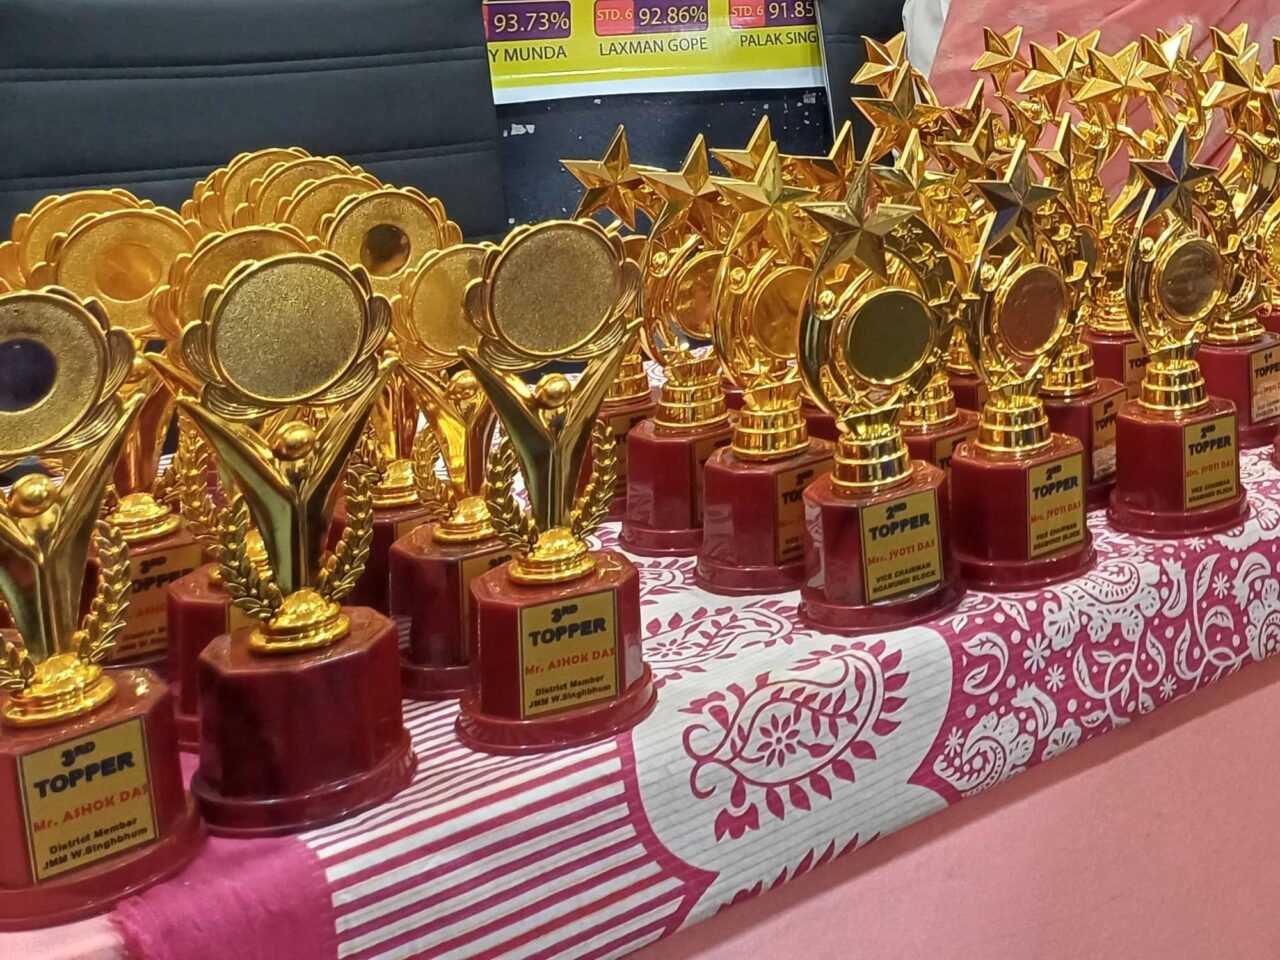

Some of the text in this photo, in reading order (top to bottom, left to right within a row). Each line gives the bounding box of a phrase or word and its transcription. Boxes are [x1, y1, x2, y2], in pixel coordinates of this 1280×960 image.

[493, 10, 570, 33] 93.73%
[597, 7, 625, 22] STD.
[638, 5, 707, 27] 92.86%
[731, 5, 754, 17] STD.
[599, 37, 709, 57] LAXMAN GOPE
[740, 32, 784, 48] PALAK
[503, 44, 568, 63] MUNDA
[1200, 424, 1216, 439] 2ND
[1187, 435, 1232, 457] TOPPER
[1045, 464, 1062, 481] 2ND
[1032, 475, 1079, 501] TOPPER
[885, 501, 907, 521] 2ND
[1046, 505, 1067, 523] JYOTI
[868, 512, 931, 541] TOPPER
[888, 545, 915, 561] JYOTI
[875, 572, 893, 584] VICE
[551, 603, 579, 624] 3RD
[528, 617, 607, 647] TOPPER
[547, 653, 589, 672] ASHOK
[535, 675, 605, 698] District Member
[61, 741, 96, 768] 3RD
[33, 751, 137, 800] TOPPER
[33, 795, 117, 834] Mr. ASHOK
[49, 816, 139, 856] District Member
[43, 826, 148, 871] JMM W.Singhbhum
